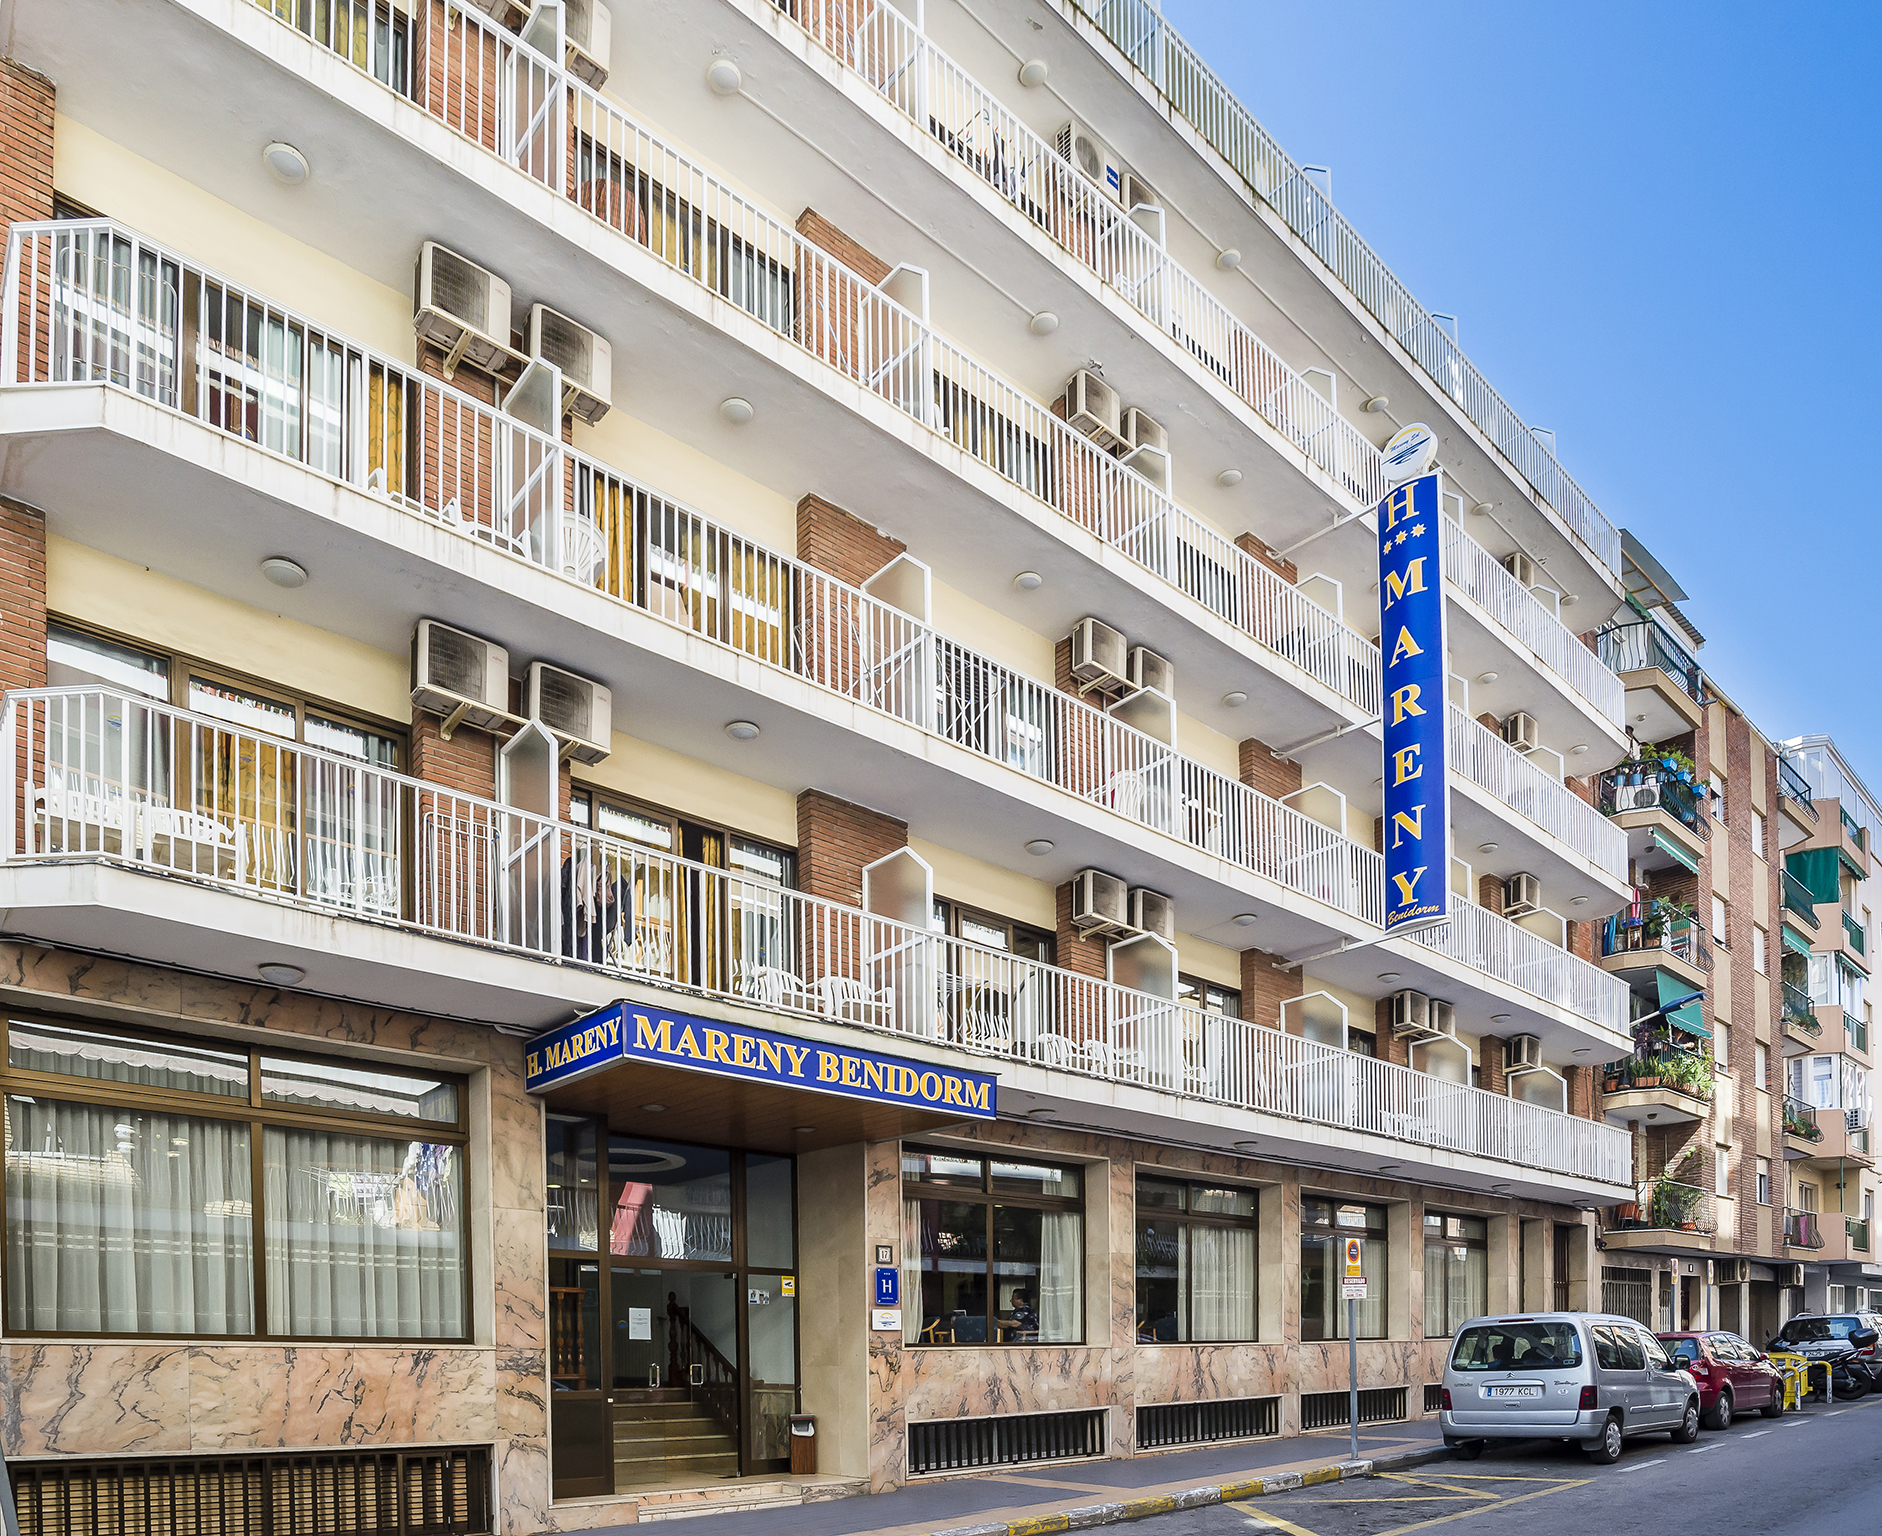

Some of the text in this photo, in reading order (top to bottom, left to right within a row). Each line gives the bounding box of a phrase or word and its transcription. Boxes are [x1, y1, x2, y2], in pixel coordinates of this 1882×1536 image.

[1384, 481, 1420, 533] H
[1383, 556, 1428, 907] MARENY
[1387, 904, 1440, 926] Benidorm
[526, 1015, 622, 1079] H. MARENY
[632, 1013, 991, 1111] MARENY BENIDORM
[881, 1250, 888, 1259] 17
[881, 1279, 892, 1294] H
[1494, 1387, 1534, 1396] 1977 KCL
